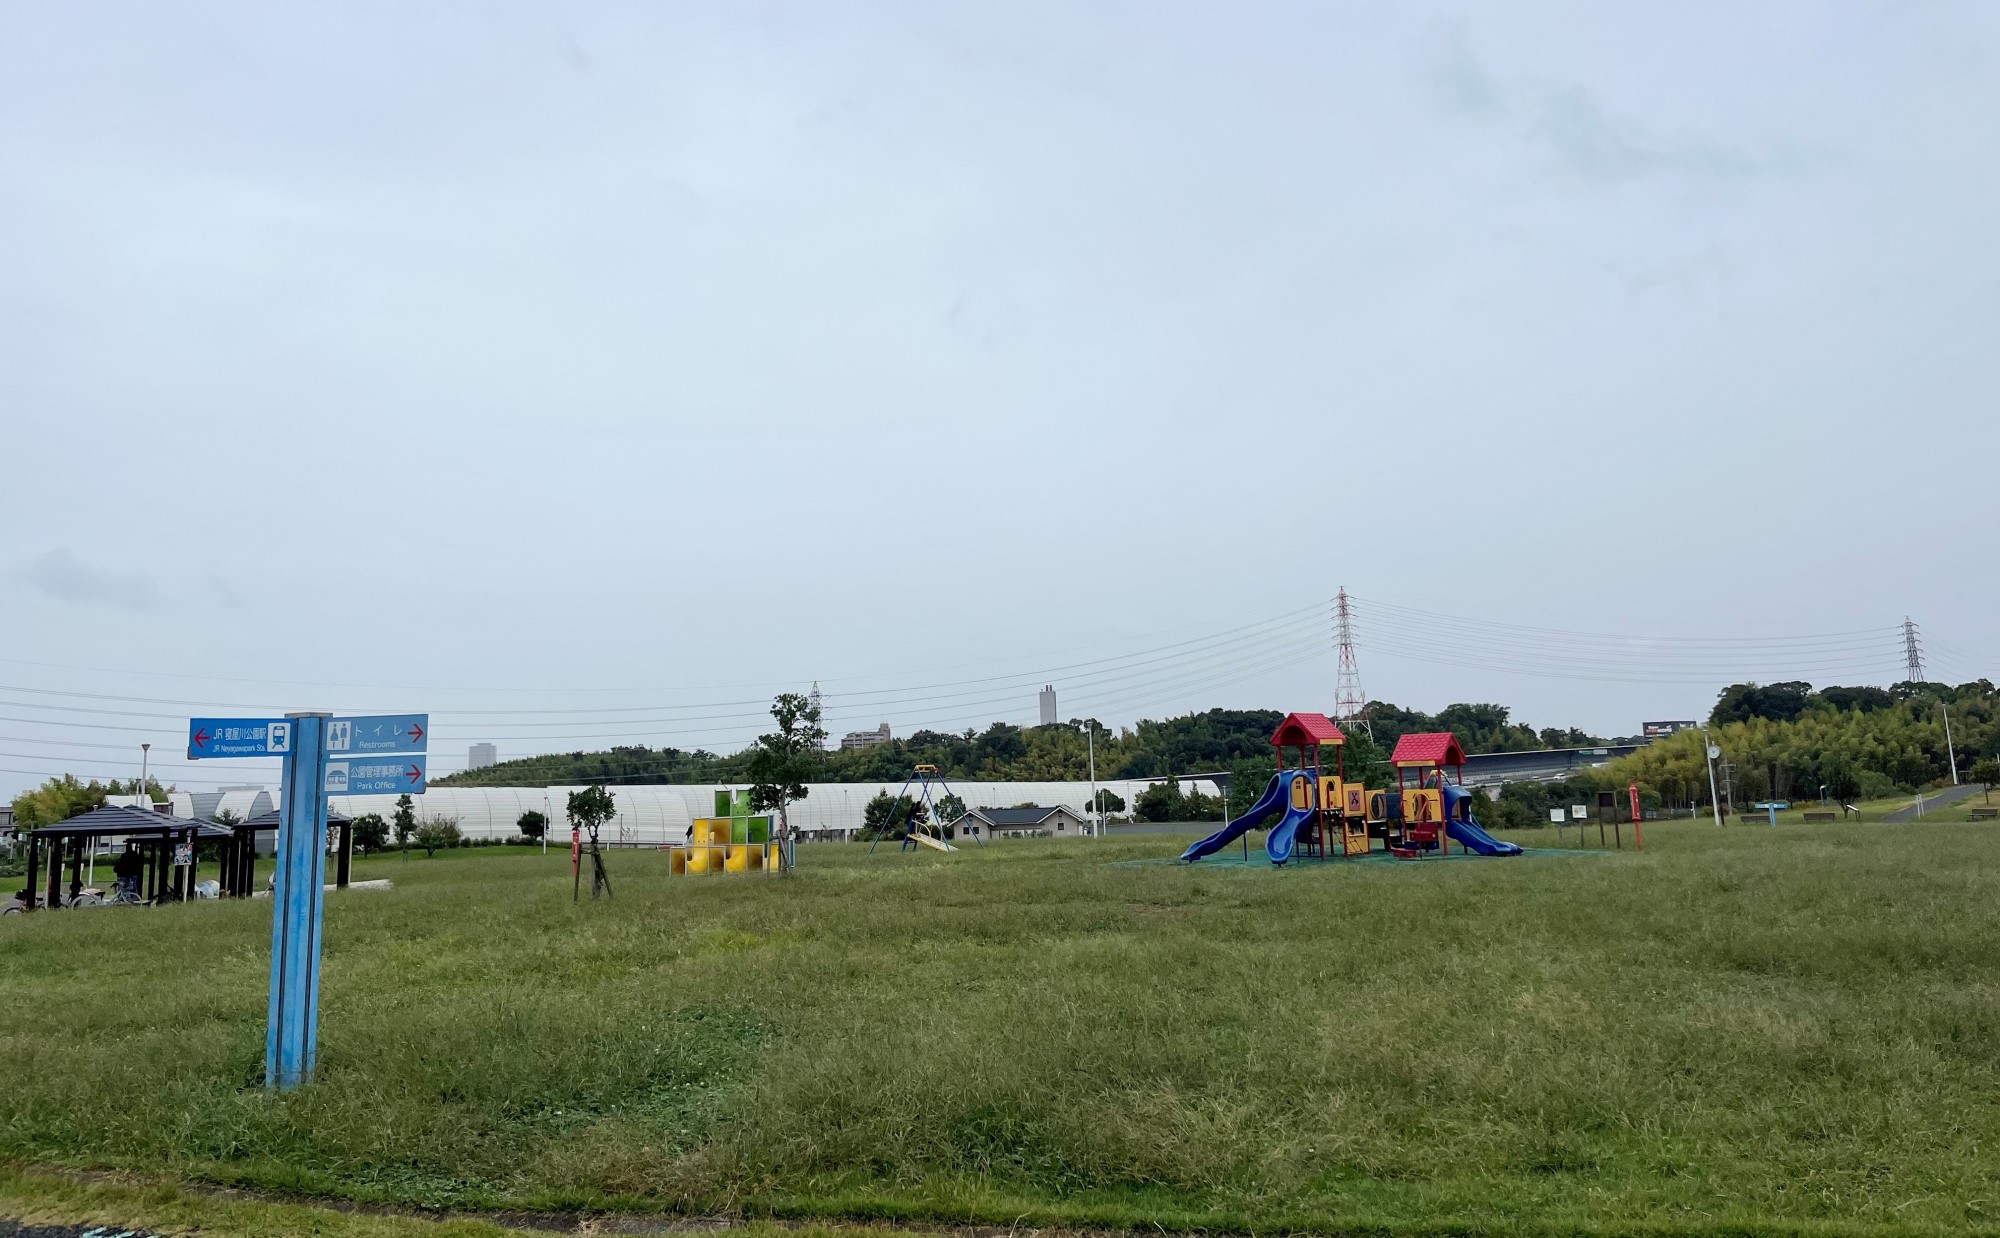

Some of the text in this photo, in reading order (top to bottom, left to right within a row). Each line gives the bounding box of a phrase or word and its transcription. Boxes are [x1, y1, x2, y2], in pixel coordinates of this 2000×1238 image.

[213, 727, 266, 740] JR 寝屋川公園駅
[355, 724, 403, 737] トイレ
[350, 764, 404, 778] 公園管理事務所
[374, 781, 396, 789] Office
